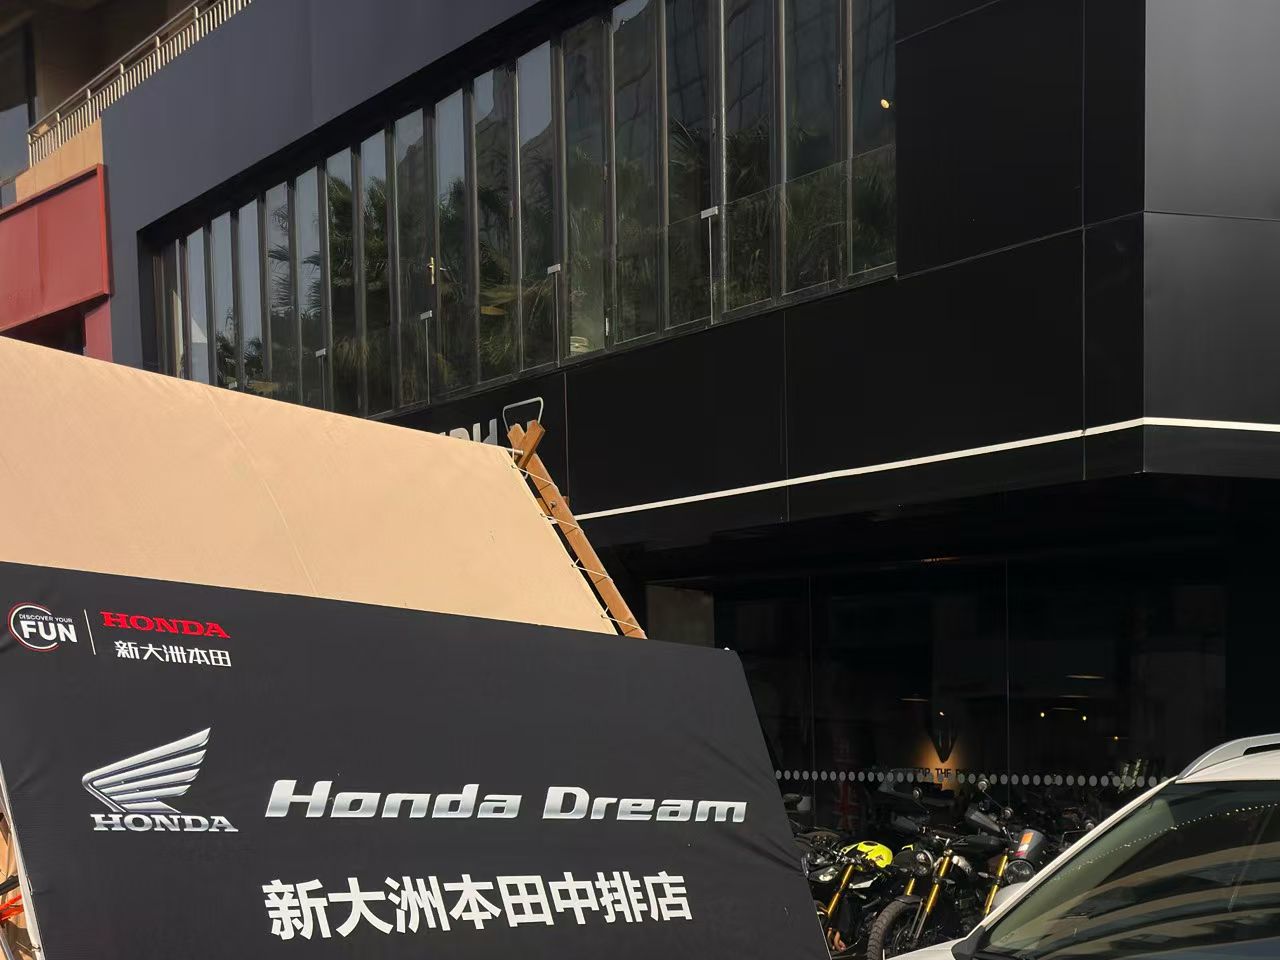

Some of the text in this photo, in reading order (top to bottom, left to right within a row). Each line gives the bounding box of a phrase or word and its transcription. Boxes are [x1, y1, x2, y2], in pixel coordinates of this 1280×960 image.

[19, 613, 53, 622] DISCOVER
[100, 611, 231, 639] HONDA
[19, 620, 78, 643] FUN
[114, 640, 232, 667] 新大洲本田
[264, 779, 748, 823] Honda Dream
[90, 813, 239, 833] HONDA
[261, 870, 693, 941] 新大洲本田中排店
